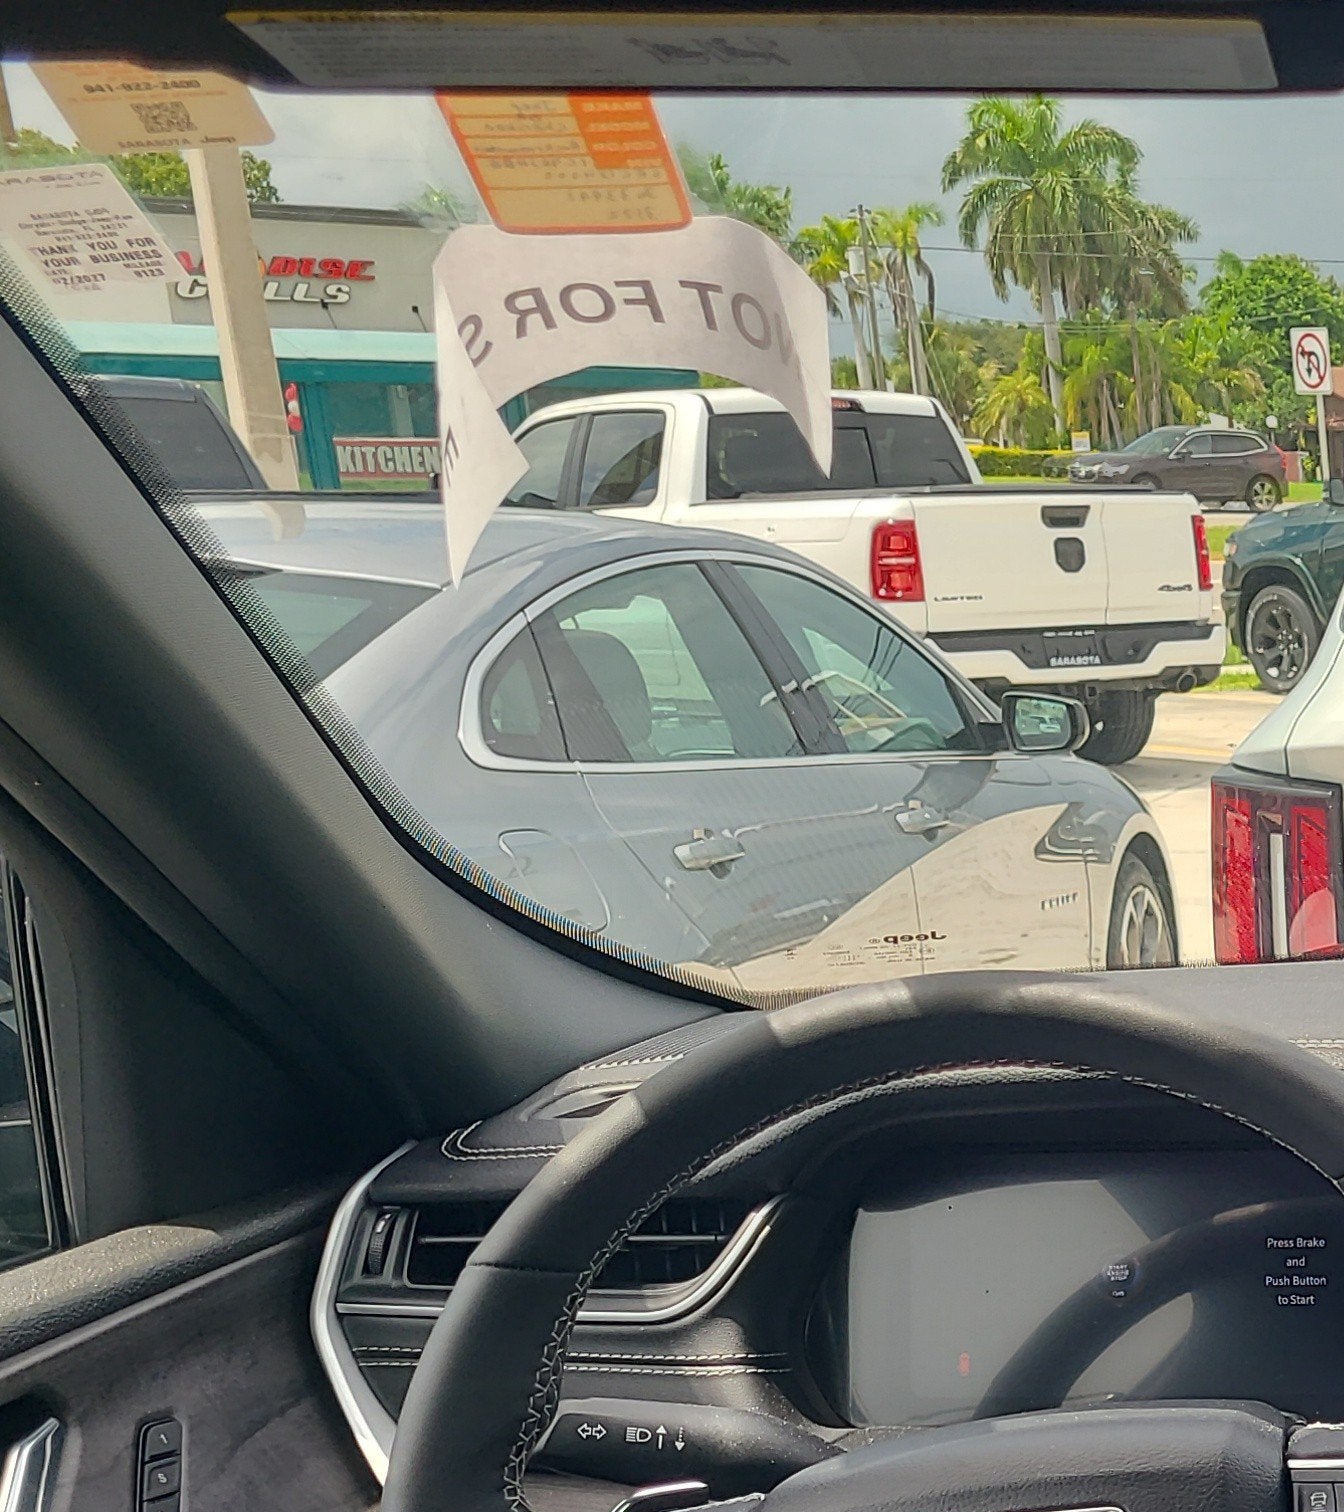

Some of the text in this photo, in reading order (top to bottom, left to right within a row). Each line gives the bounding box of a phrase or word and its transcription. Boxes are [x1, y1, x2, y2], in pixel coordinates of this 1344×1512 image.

[28, 237, 157, 258] THANK YOU FOR
[42, 249, 164, 269] YOUR BUSINESS
[336, 445, 441, 474] KITCHEN
[1050, 655, 1101, 667] SARASOTA
[1266, 1237, 1326, 1249] Press Brake
[1286, 1256, 1306, 1267] and
[1265, 1275, 1327, 1287] Push Button
[1277, 1294, 1315, 1305] to Start
[160, 1433, 169, 1445] 1
